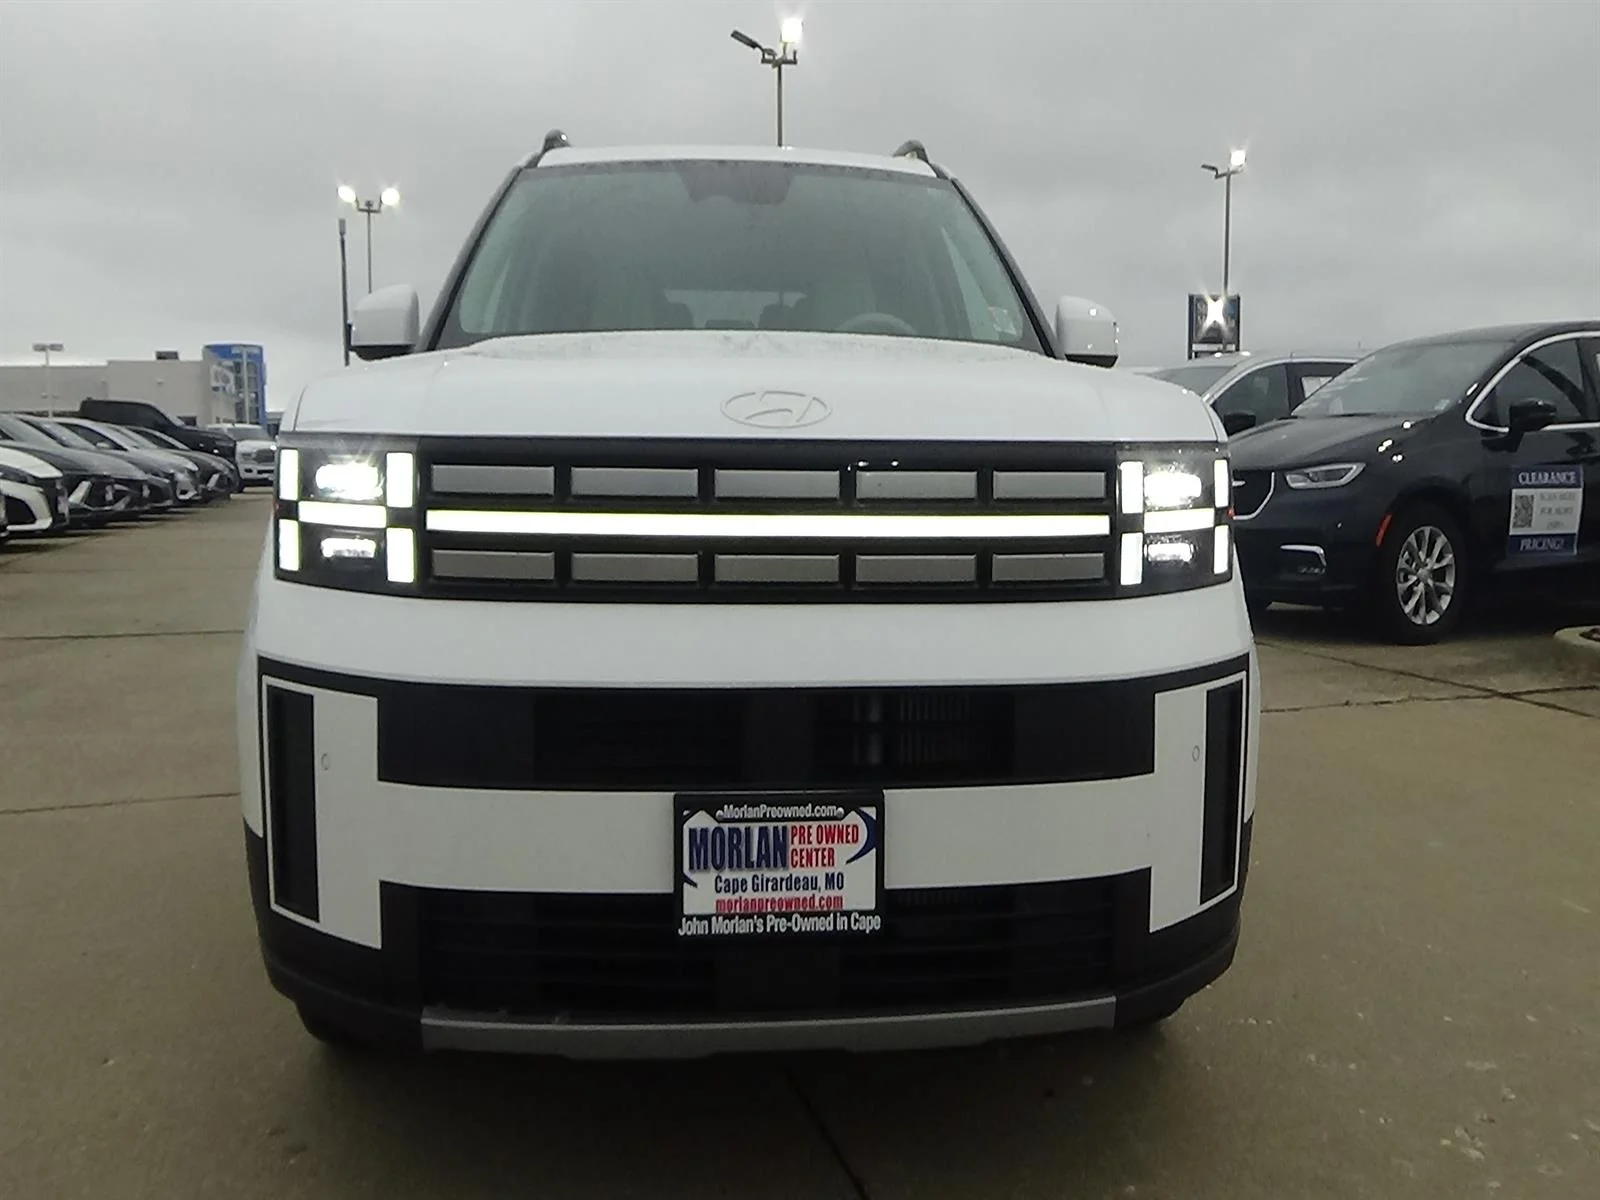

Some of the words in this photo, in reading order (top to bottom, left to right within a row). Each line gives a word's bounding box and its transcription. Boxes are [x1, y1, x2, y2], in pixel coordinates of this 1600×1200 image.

[790, 825, 813, 845] PRE
[816, 823, 860, 845] OWNED
[688, 825, 789, 871] MORLAN
[790, 847, 836, 868] CENTER
[714, 874, 748, 895] Cape
[751, 873, 822, 897] Girardeau,
[824, 872, 844, 891] MO
[715, 894, 844, 913] morlanpreowned.com
[678, 917, 709, 936] John
[711, 915, 764, 934] Morlan's
[766, 914, 834, 933] Pre-Owned
[836, 913, 847, 931] in
[850, 912, 882, 934] Cape
